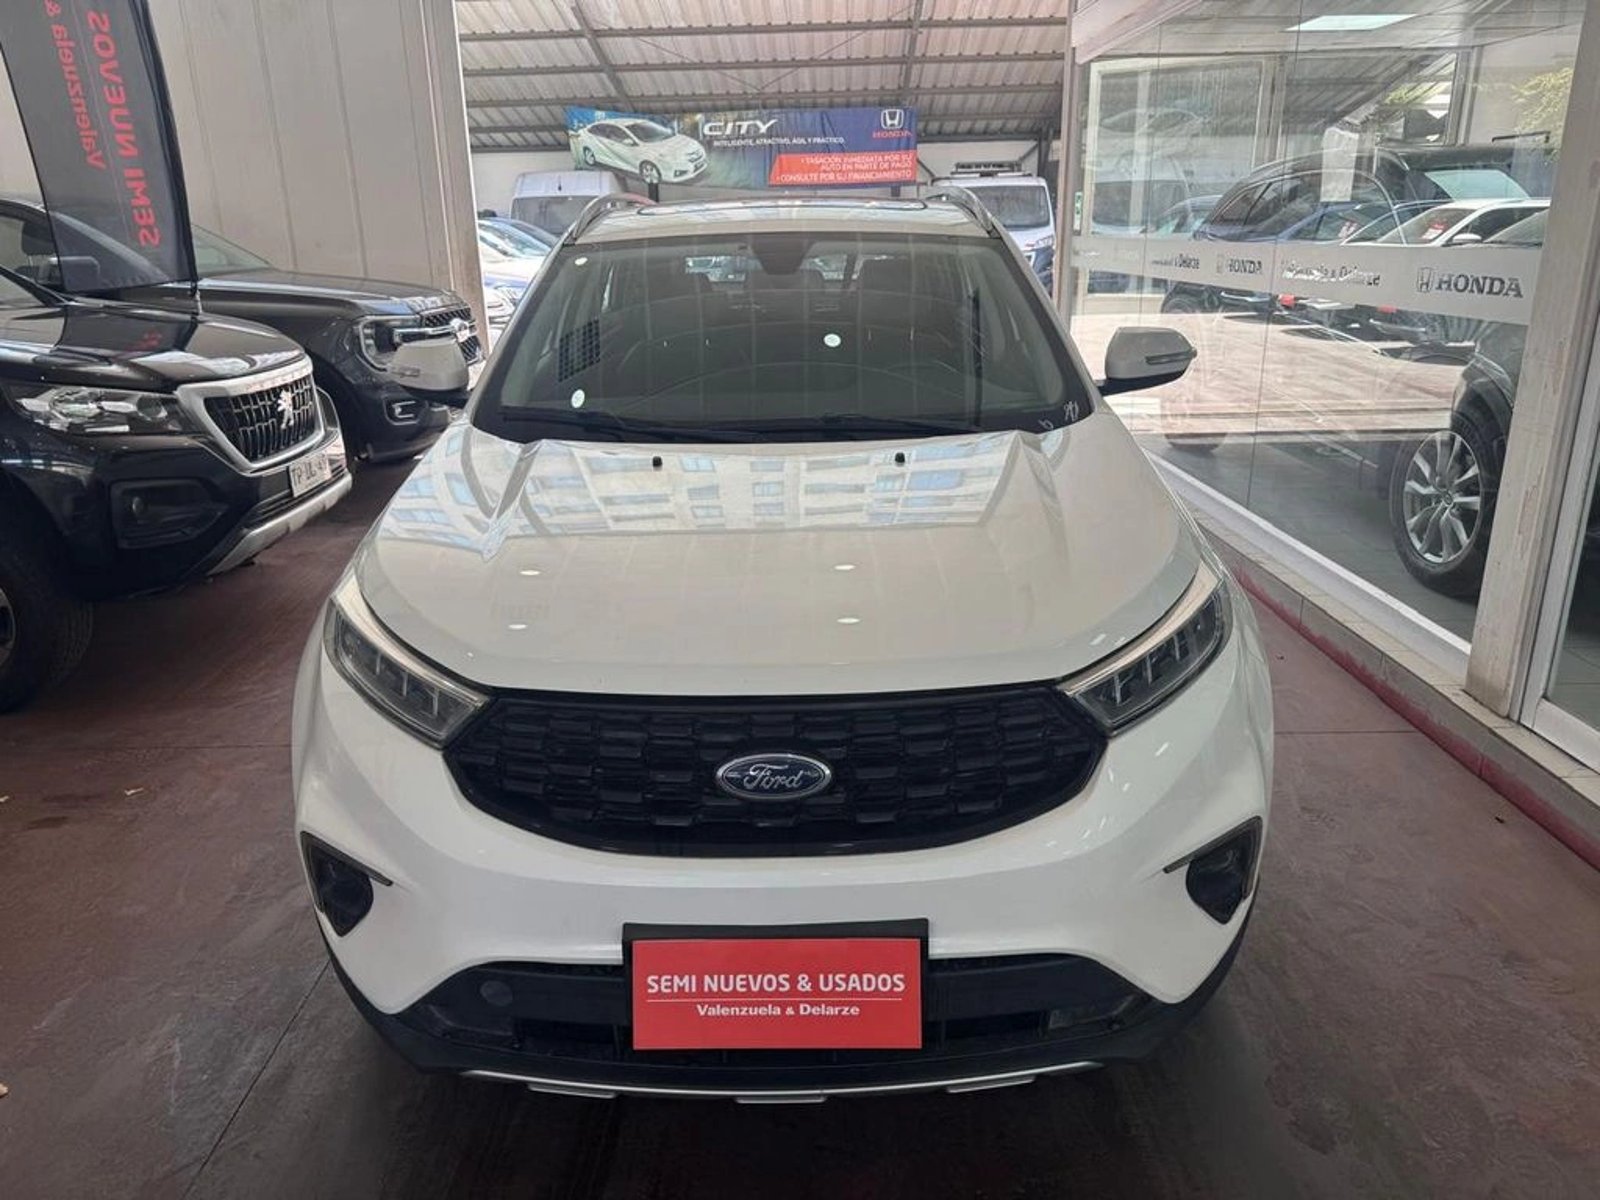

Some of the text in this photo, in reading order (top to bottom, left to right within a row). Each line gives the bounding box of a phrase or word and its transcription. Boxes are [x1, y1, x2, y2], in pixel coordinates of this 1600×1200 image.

[703, 119, 778, 135] CITY
[872, 130, 913, 138] HONDA
[1436, 273, 1524, 298] HONDA
[743, 763, 804, 790] Ford
[647, 973, 906, 994] SEMI NUEVOS & USADOS
[697, 1003, 860, 1017] Valenzuela & Delarze
